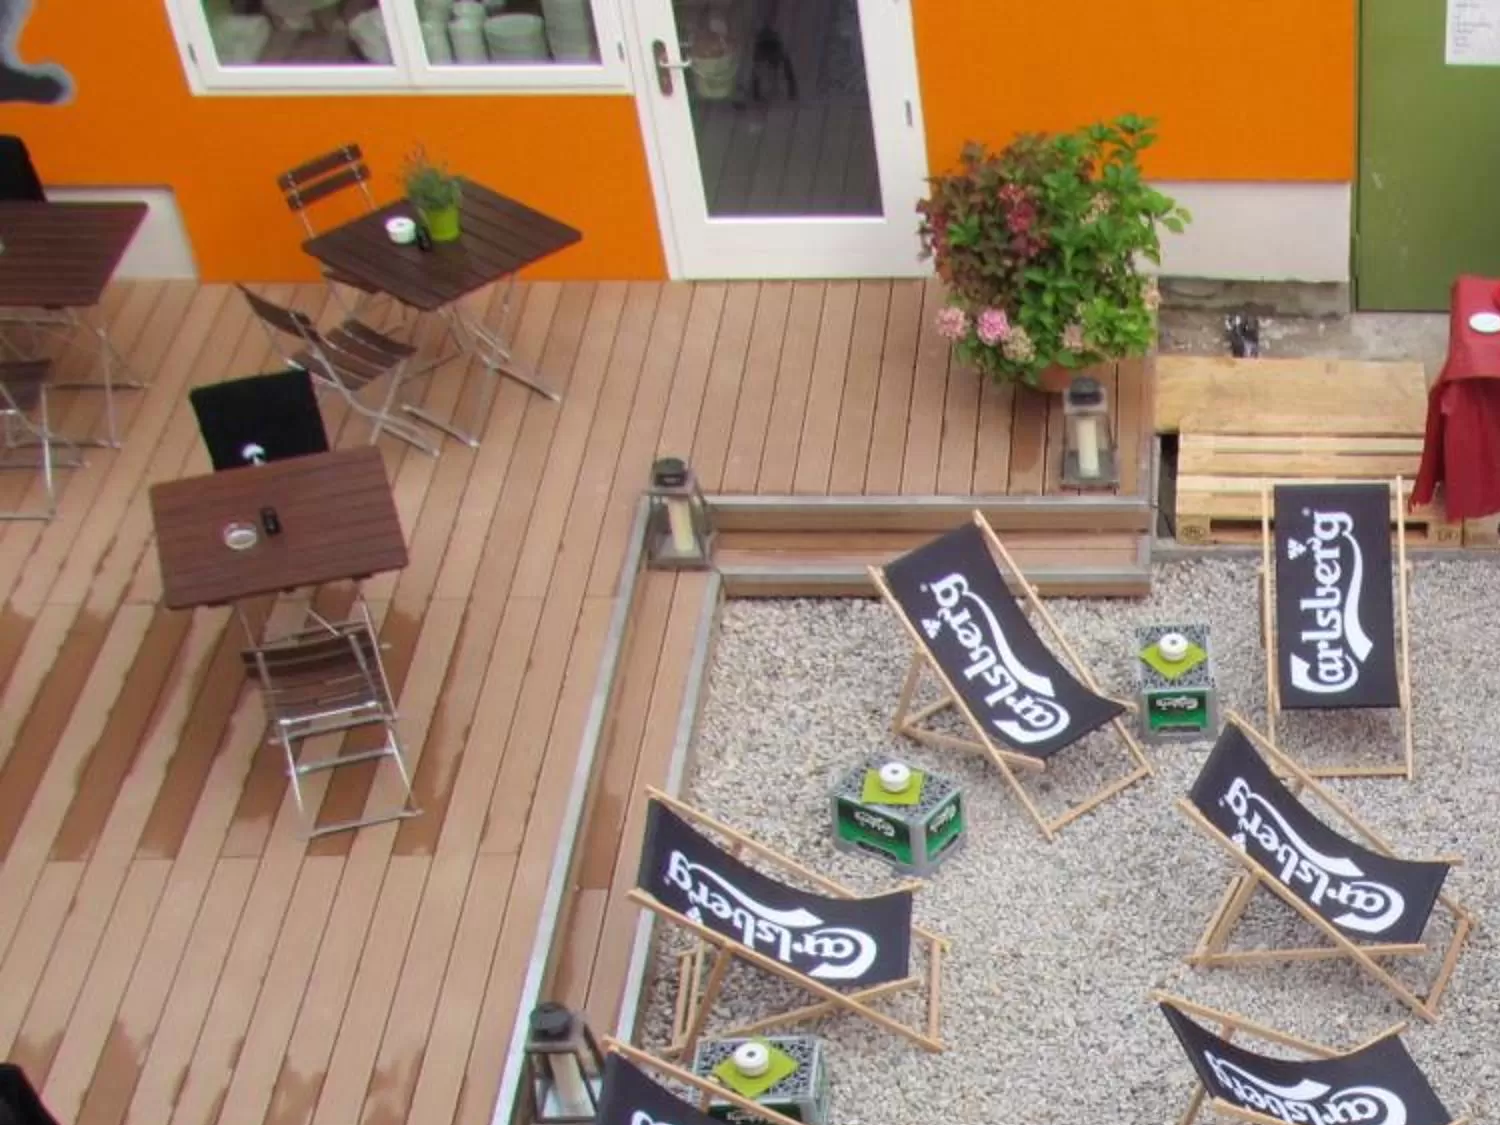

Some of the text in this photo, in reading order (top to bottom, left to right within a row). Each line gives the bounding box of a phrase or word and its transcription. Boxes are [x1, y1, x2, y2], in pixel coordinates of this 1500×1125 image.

[930, 573, 1070, 743] Carlsberg
[1286, 511, 1374, 693] Carlsberg
[668, 850, 877, 979] Carlsberg
[1225, 778, 1405, 933] Carlsberg
